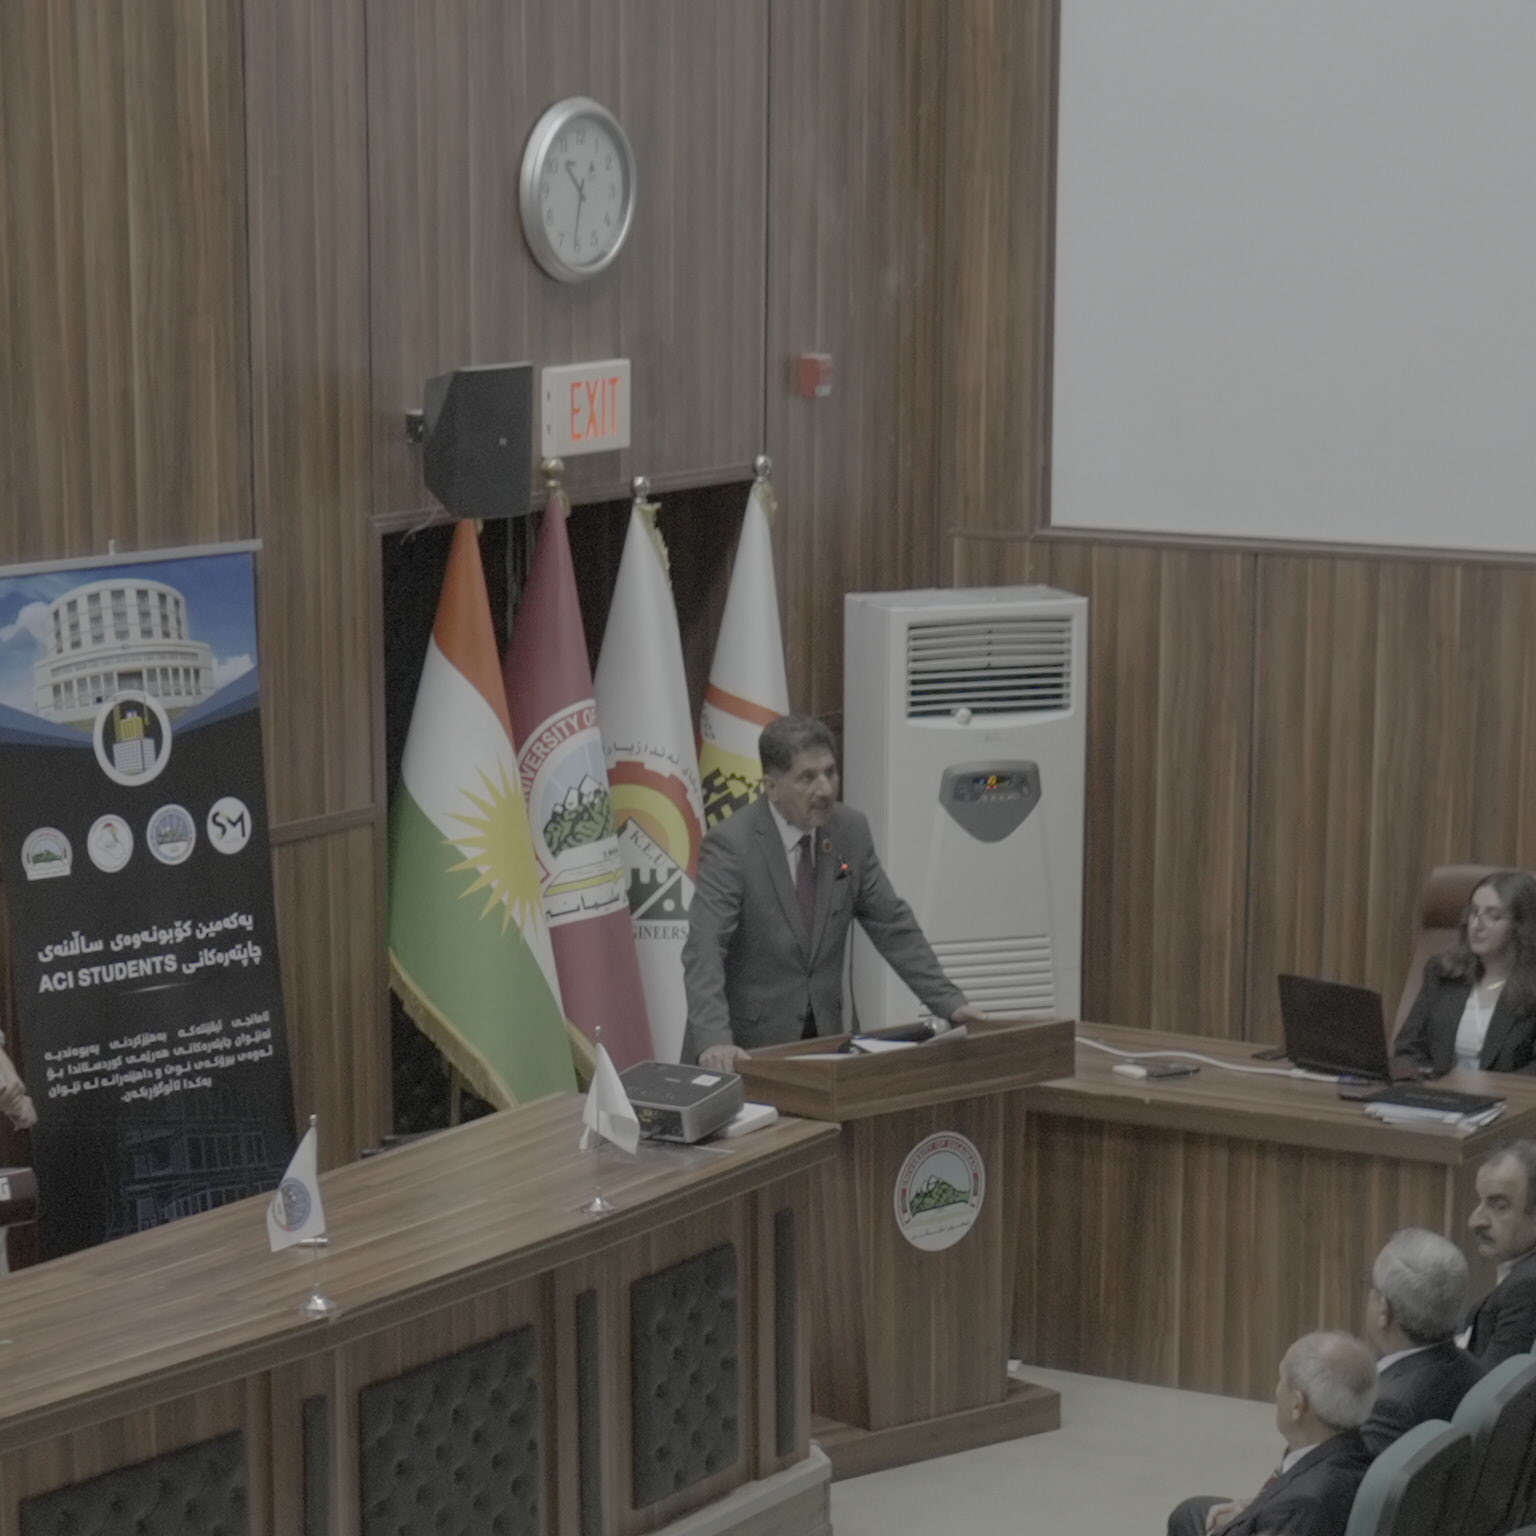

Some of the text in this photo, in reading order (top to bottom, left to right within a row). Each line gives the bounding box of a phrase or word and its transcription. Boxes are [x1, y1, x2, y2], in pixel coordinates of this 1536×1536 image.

[560, 138, 569, 152] 11
[576, 129, 586, 145] 12
[546, 157, 558, 174] 10
[570, 377, 620, 441] EXIT
[39, 954, 177, 993] ACI STUDENTS
